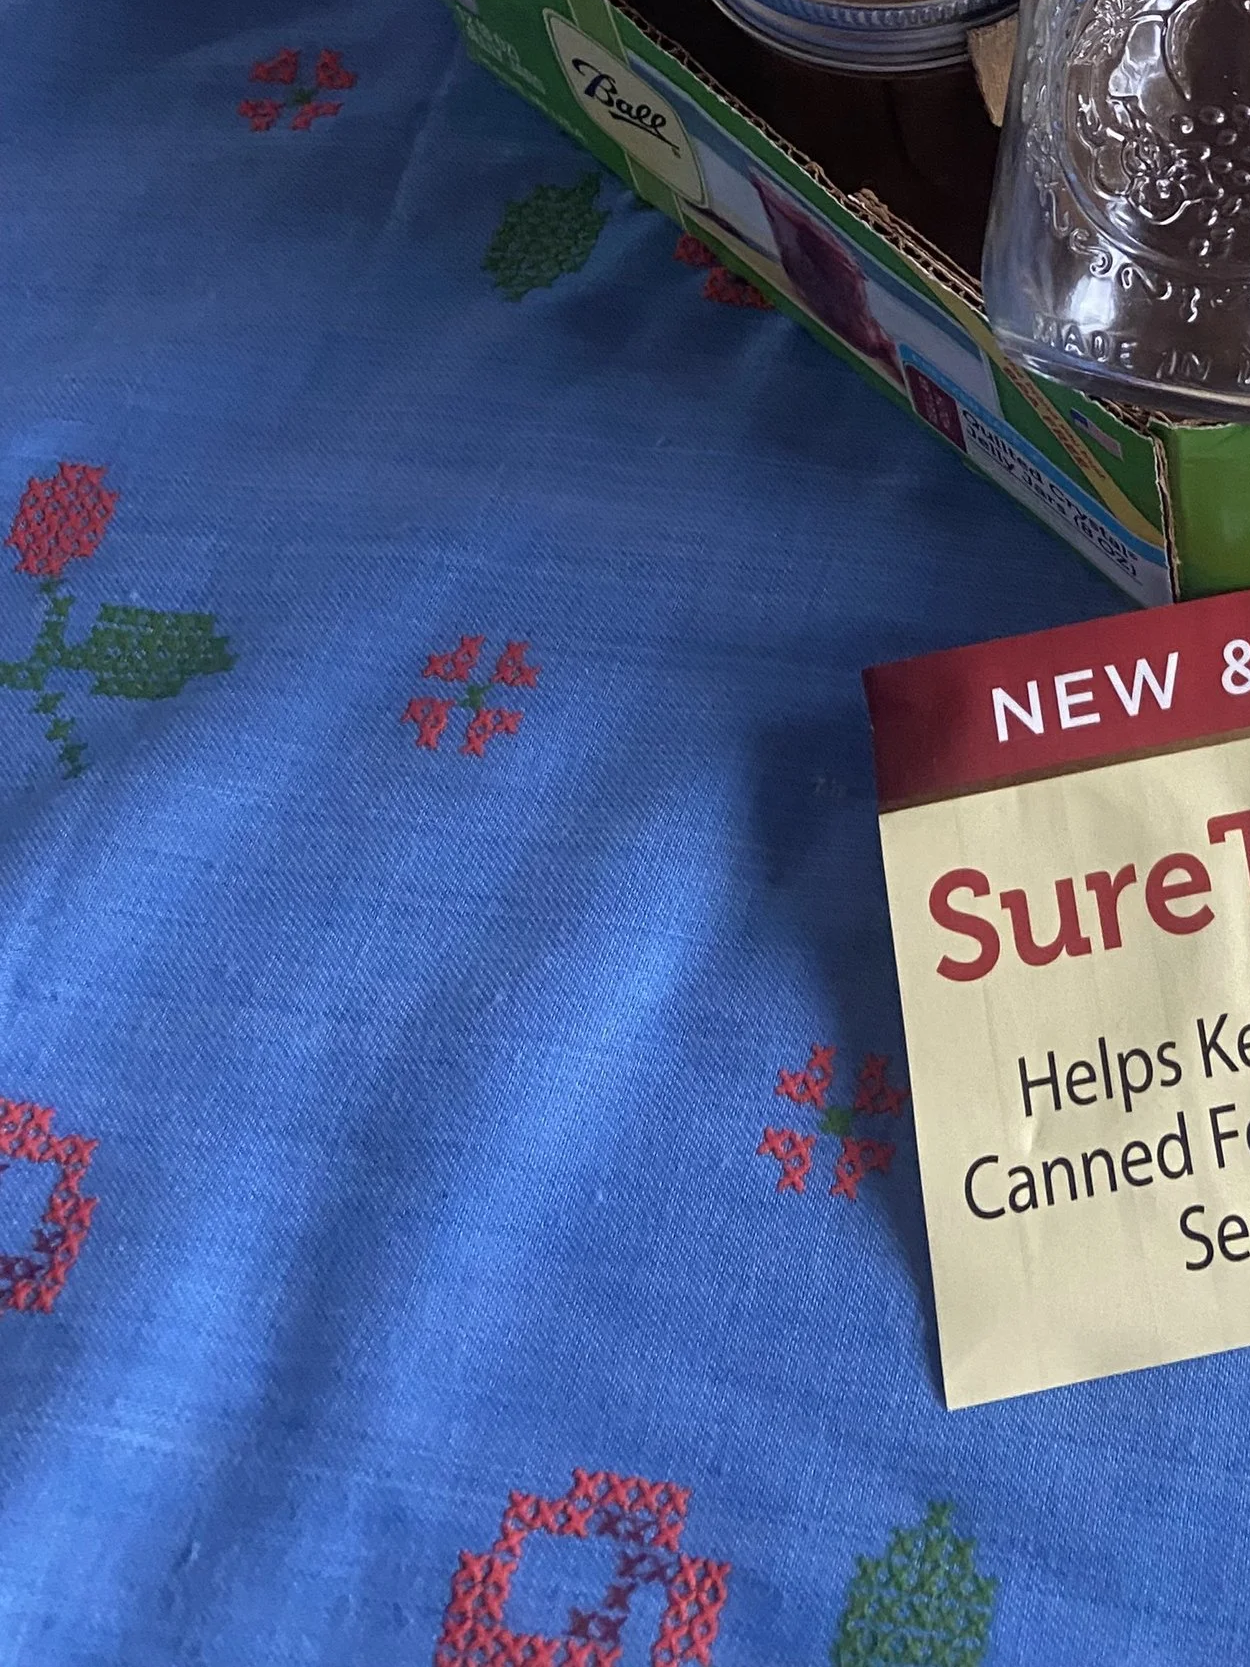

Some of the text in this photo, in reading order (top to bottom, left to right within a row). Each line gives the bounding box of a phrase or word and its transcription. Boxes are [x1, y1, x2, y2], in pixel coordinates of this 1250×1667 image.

[962, 409, 1042, 484] Quilted
[1023, 469, 1068, 516] Jars
[991, 652, 1179, 743] NEW
[1018, 1037, 1183, 1117] Helps
[964, 1111, 1194, 1220] Canned
